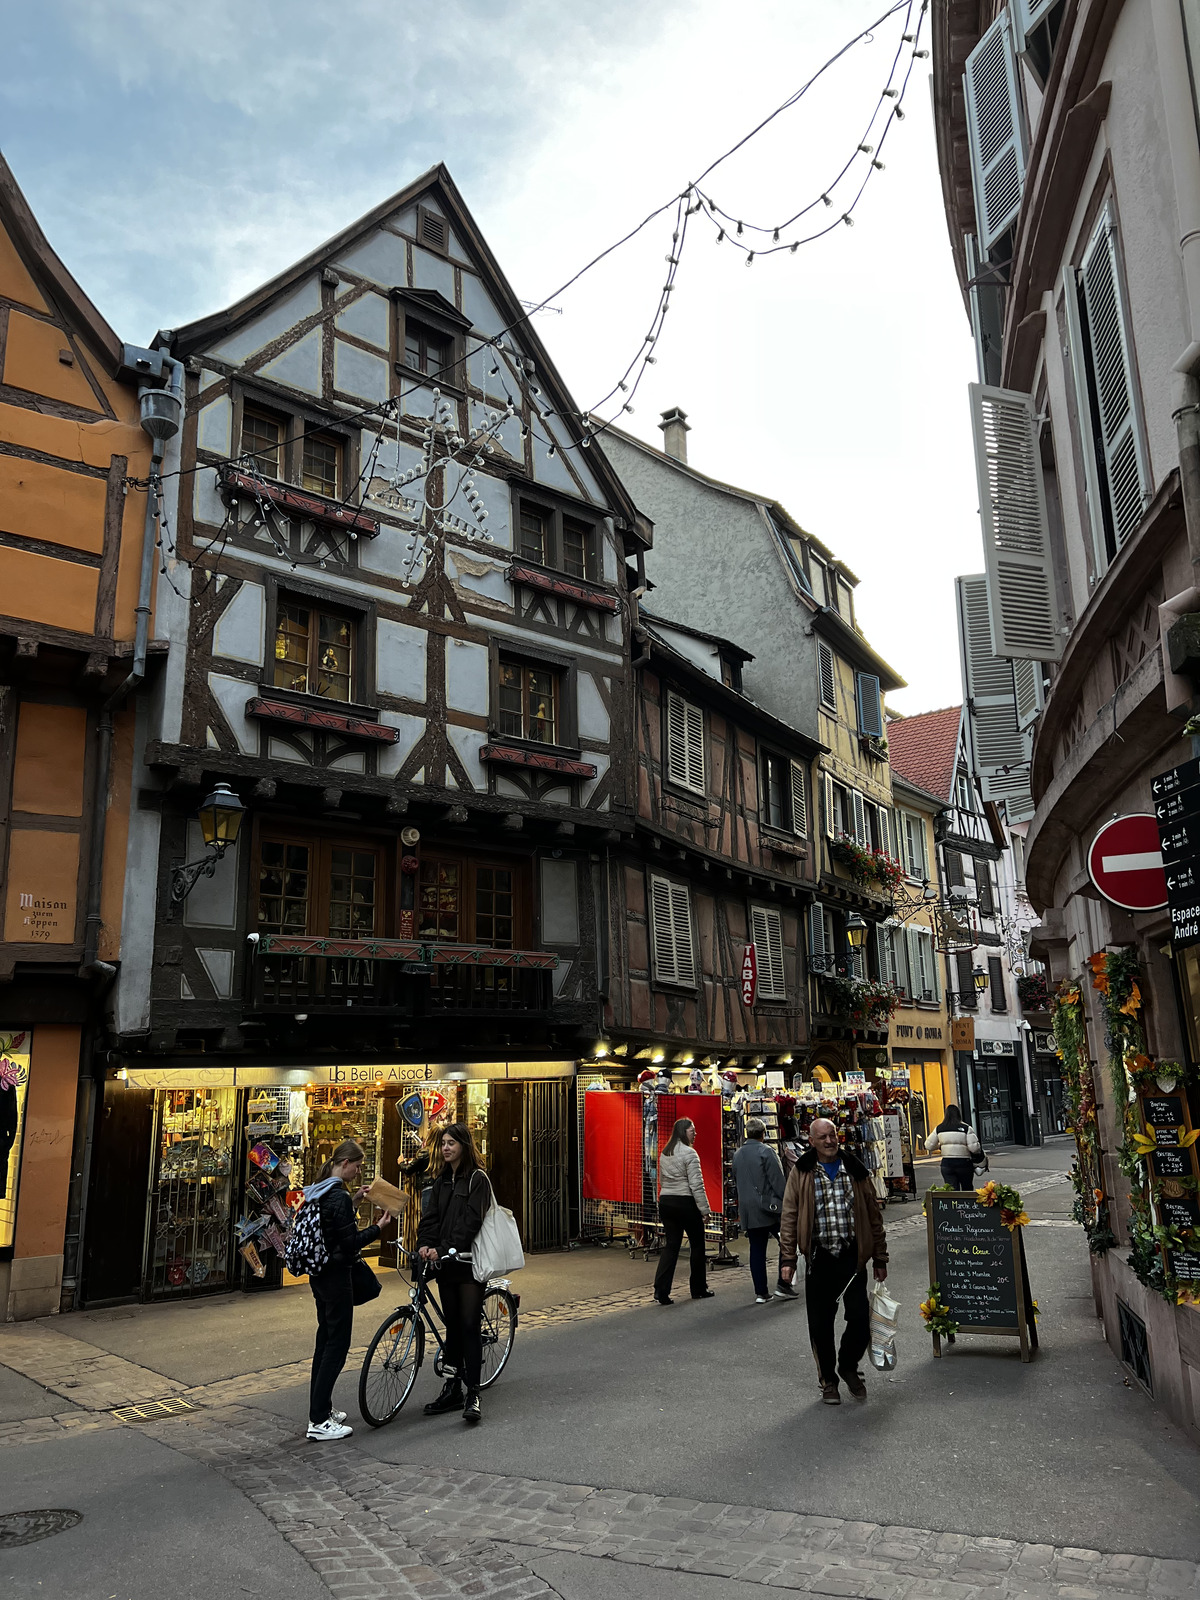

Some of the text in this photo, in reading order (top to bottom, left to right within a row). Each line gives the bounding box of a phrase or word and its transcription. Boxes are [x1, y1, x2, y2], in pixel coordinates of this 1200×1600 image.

[20, 893, 67, 911] Maison
[1172, 905, 1200, 924] Espace
[1174, 921, 1198, 940] André
[742, 945, 753, 1004] TABAC
[329, 1067, 433, 1081] La Belle Alsace
[939, 1201, 948, 1211] Au
[972, 1202, 980, 1210] de
[938, 1221, 964, 1233] Produits
[947, 1243, 960, 1255] Coup
[997, 1276, 1009, 1284] 20€
[323, 1422, 331, 1430] N
